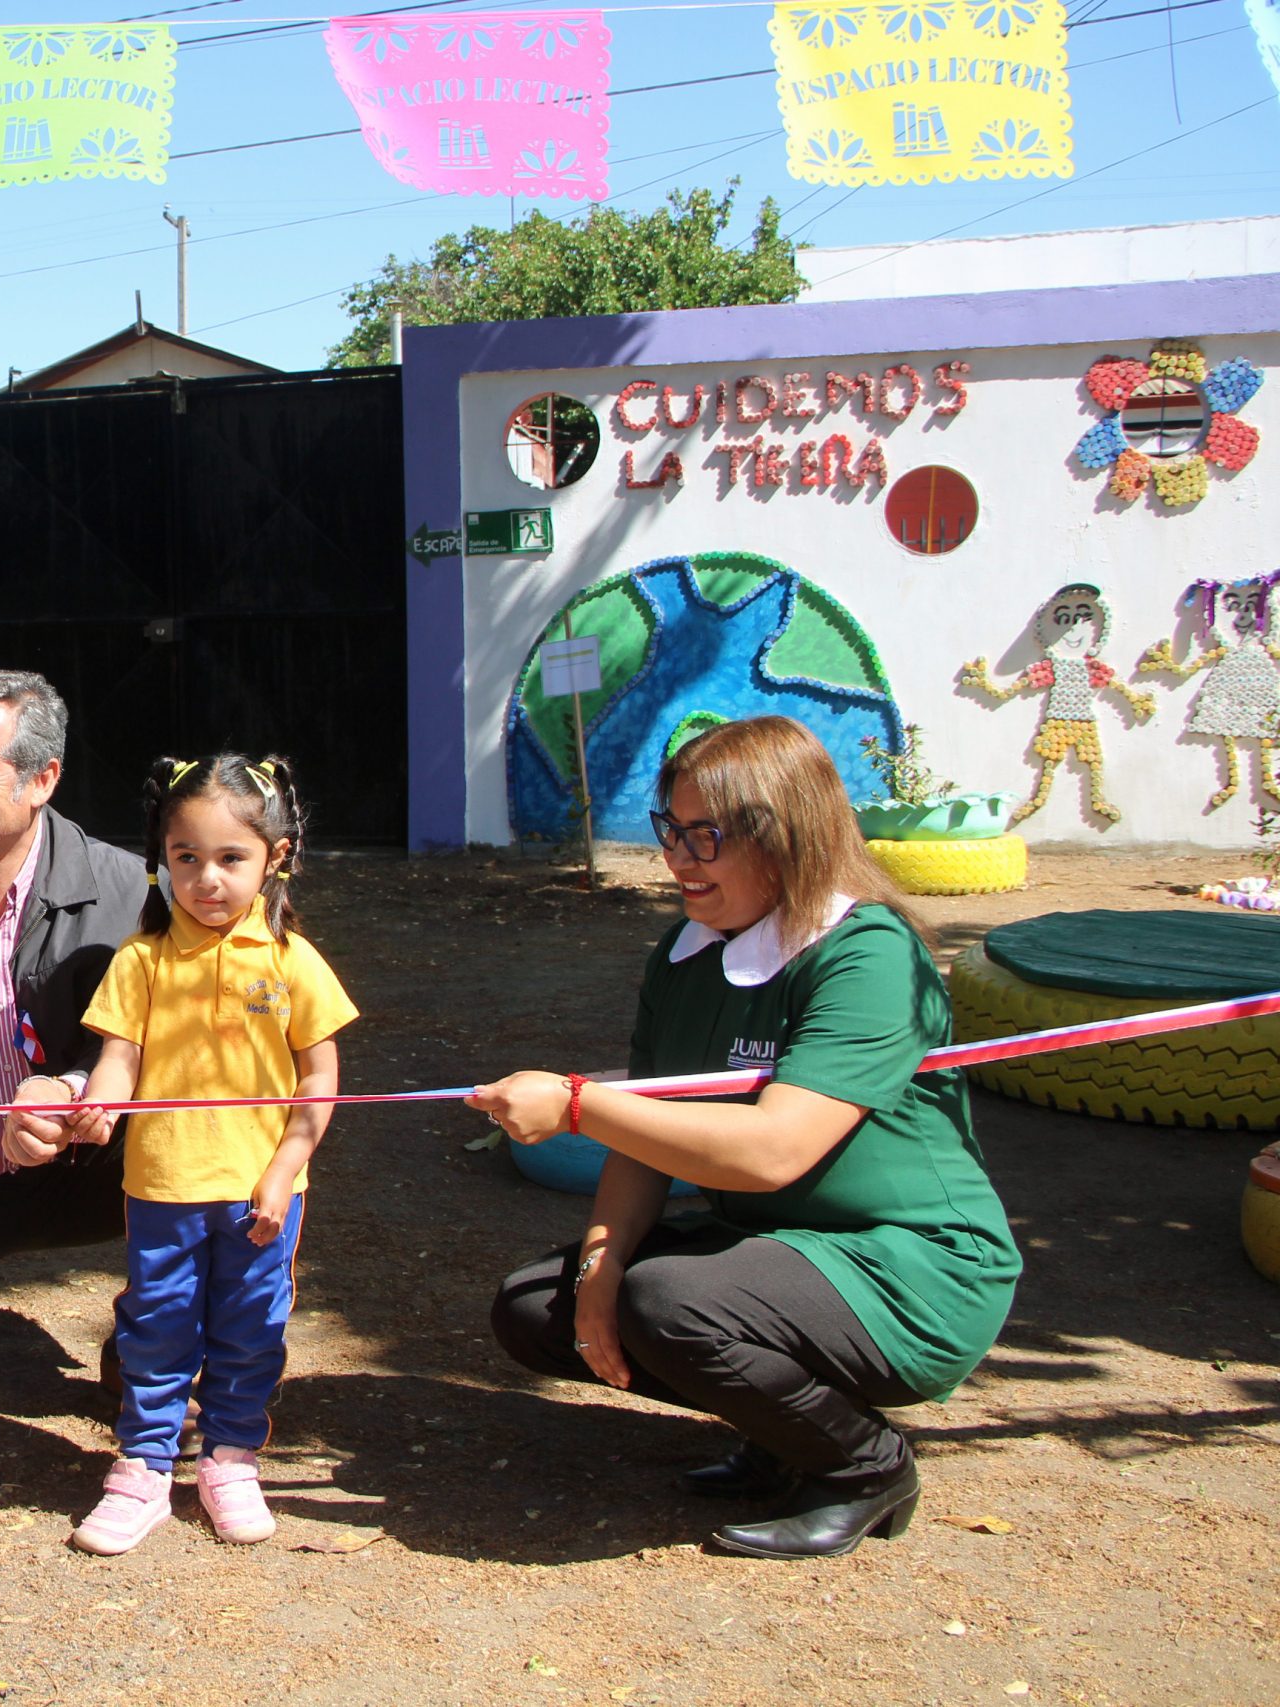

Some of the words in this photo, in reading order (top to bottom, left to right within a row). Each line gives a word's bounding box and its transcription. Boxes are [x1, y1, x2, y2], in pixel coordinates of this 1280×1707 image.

[41, 76, 159, 113] LECTOR
[475, 76, 593, 118] LECTOR
[791, 58, 920, 106] ESPACIO
[928, 56, 1052, 95] LECTOR
[616, 360, 970, 432] CUIDEMOS
[625, 450, 685, 489] LA
[729, 1037, 775, 1059] JUNJI
